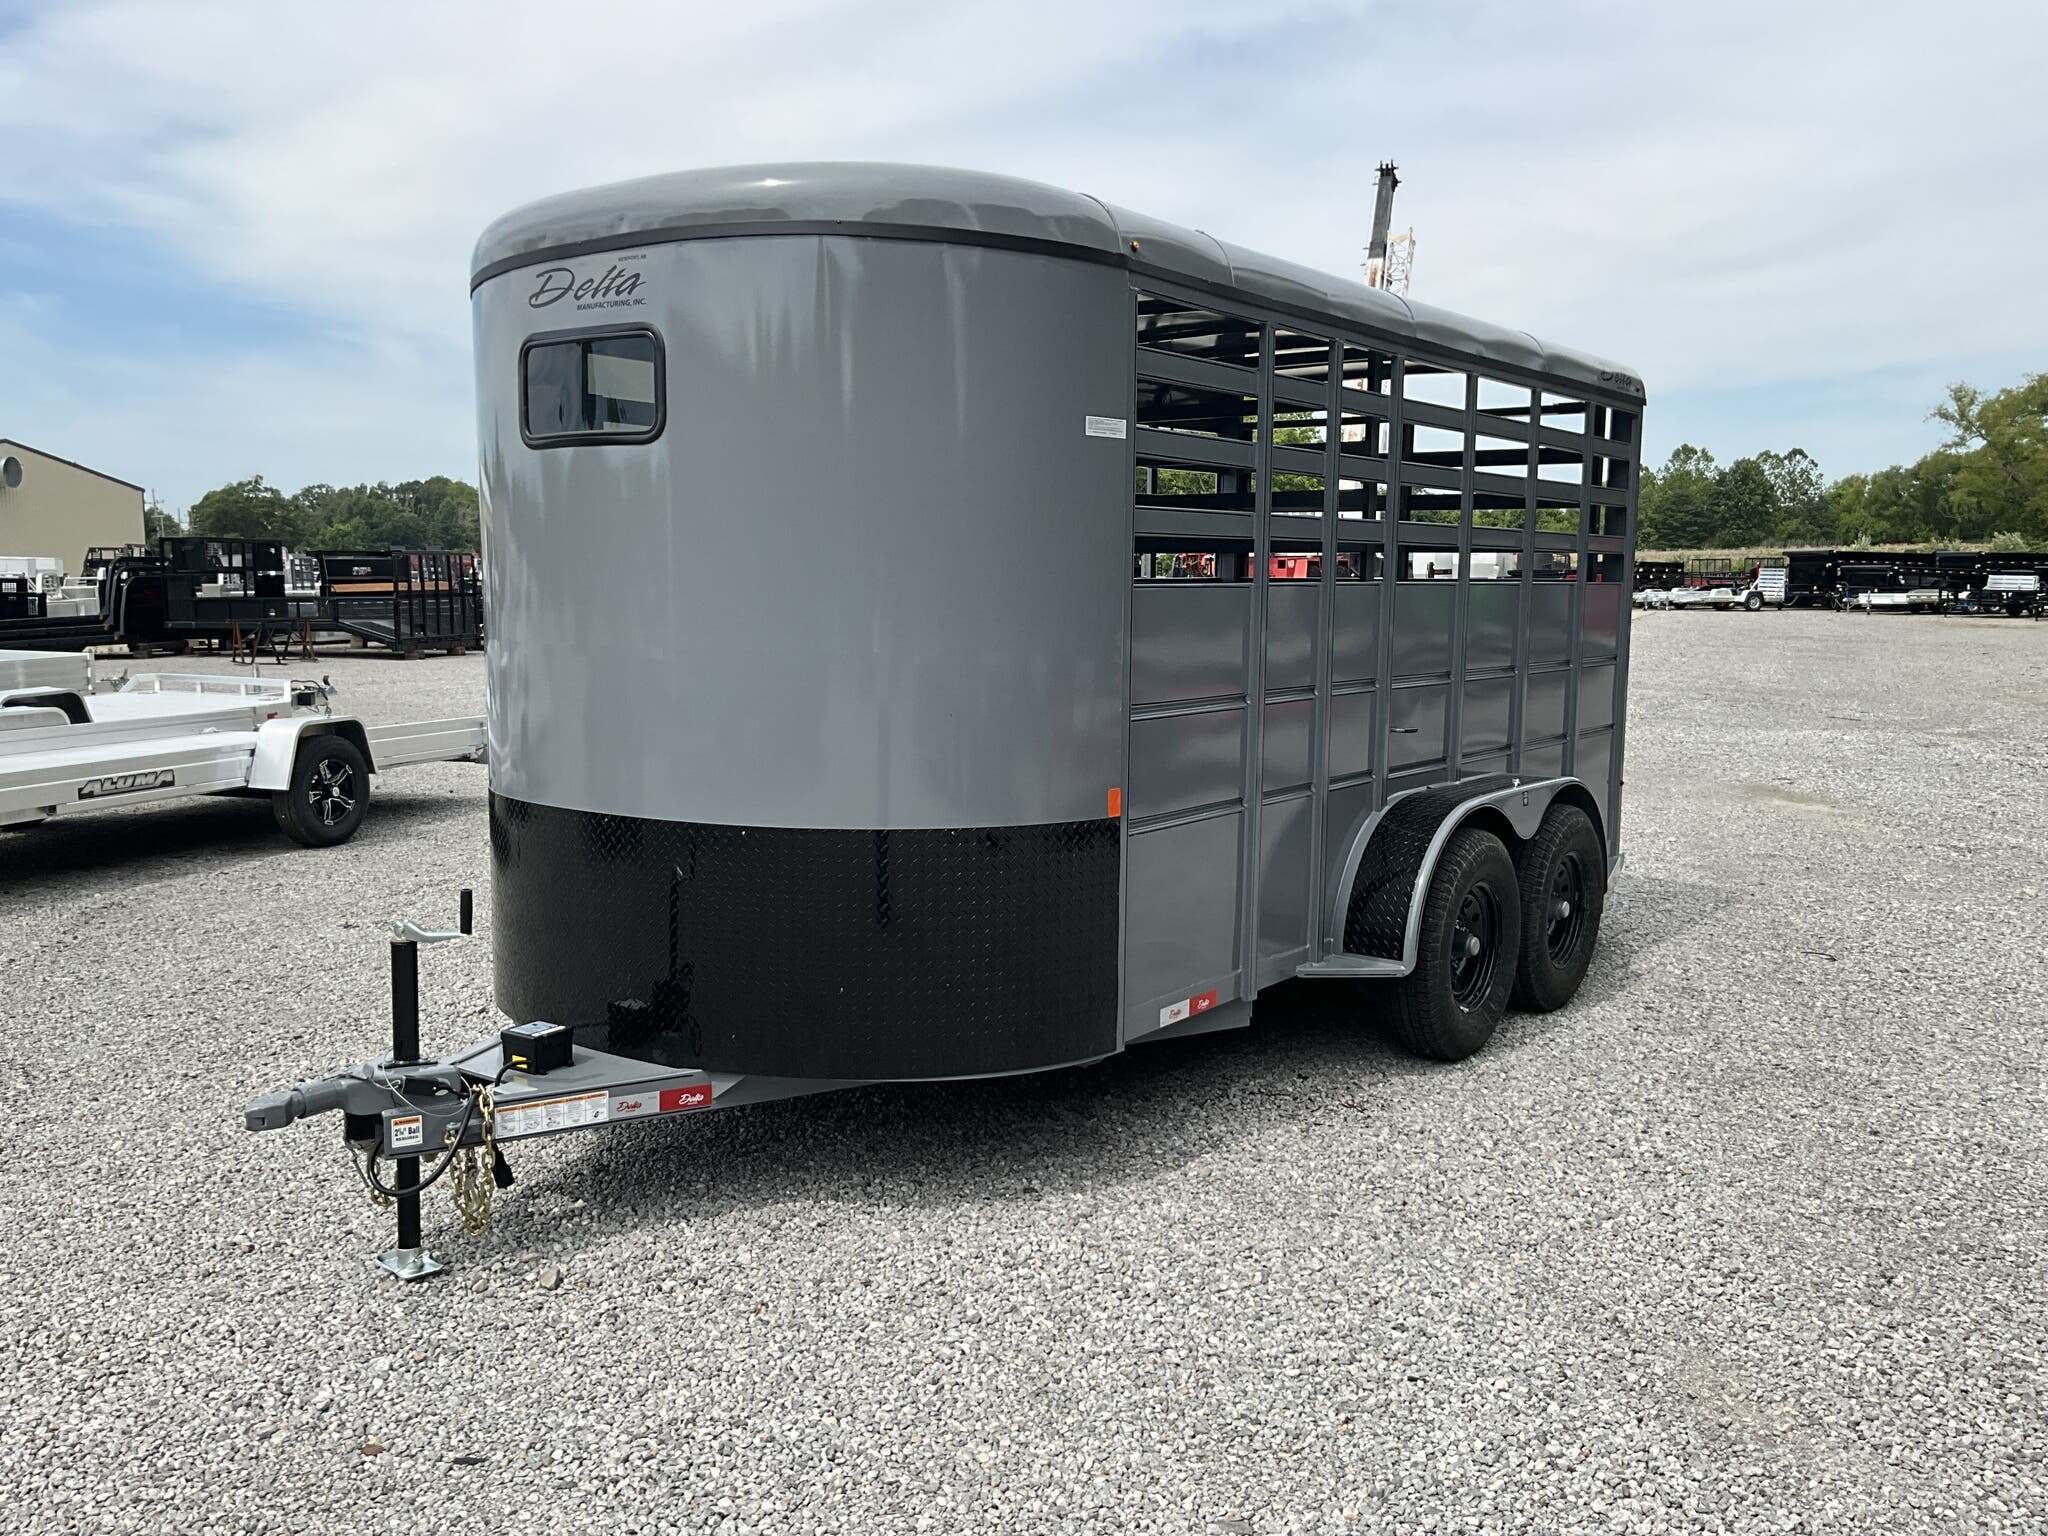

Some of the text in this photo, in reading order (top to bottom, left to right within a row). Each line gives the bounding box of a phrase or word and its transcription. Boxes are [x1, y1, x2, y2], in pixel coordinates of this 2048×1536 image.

[529, 265, 647, 309] Delta
[633, 297, 647, 306] INC.
[80, 769, 175, 798] ALUMA
[408, 1125, 420, 1135] Ball
